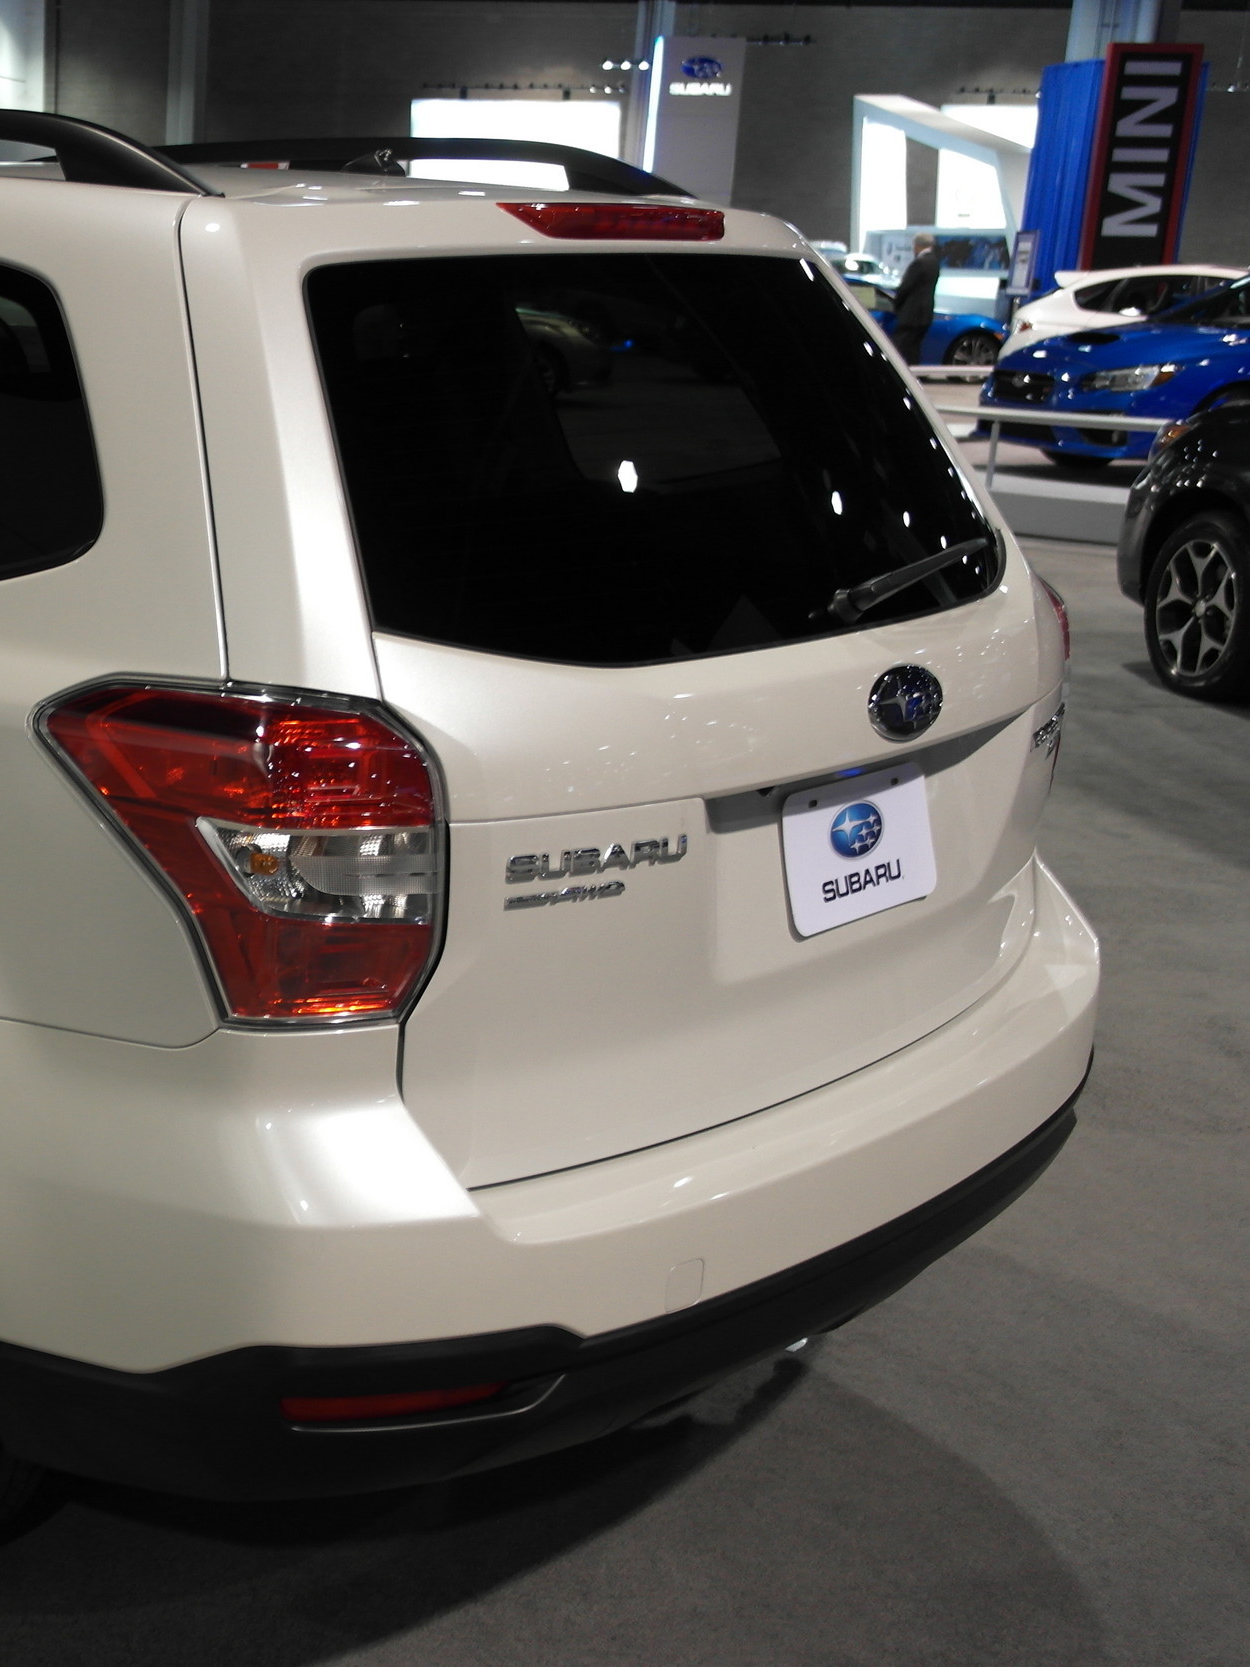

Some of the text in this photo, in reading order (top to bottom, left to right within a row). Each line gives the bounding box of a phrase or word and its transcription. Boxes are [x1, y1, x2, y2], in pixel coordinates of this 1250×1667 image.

[669, 82, 733, 96] SUBARU
[1100, 61, 1183, 237] MINI
[505, 833, 688, 885] SUBARU
[822, 858, 902, 904] SUBARU
